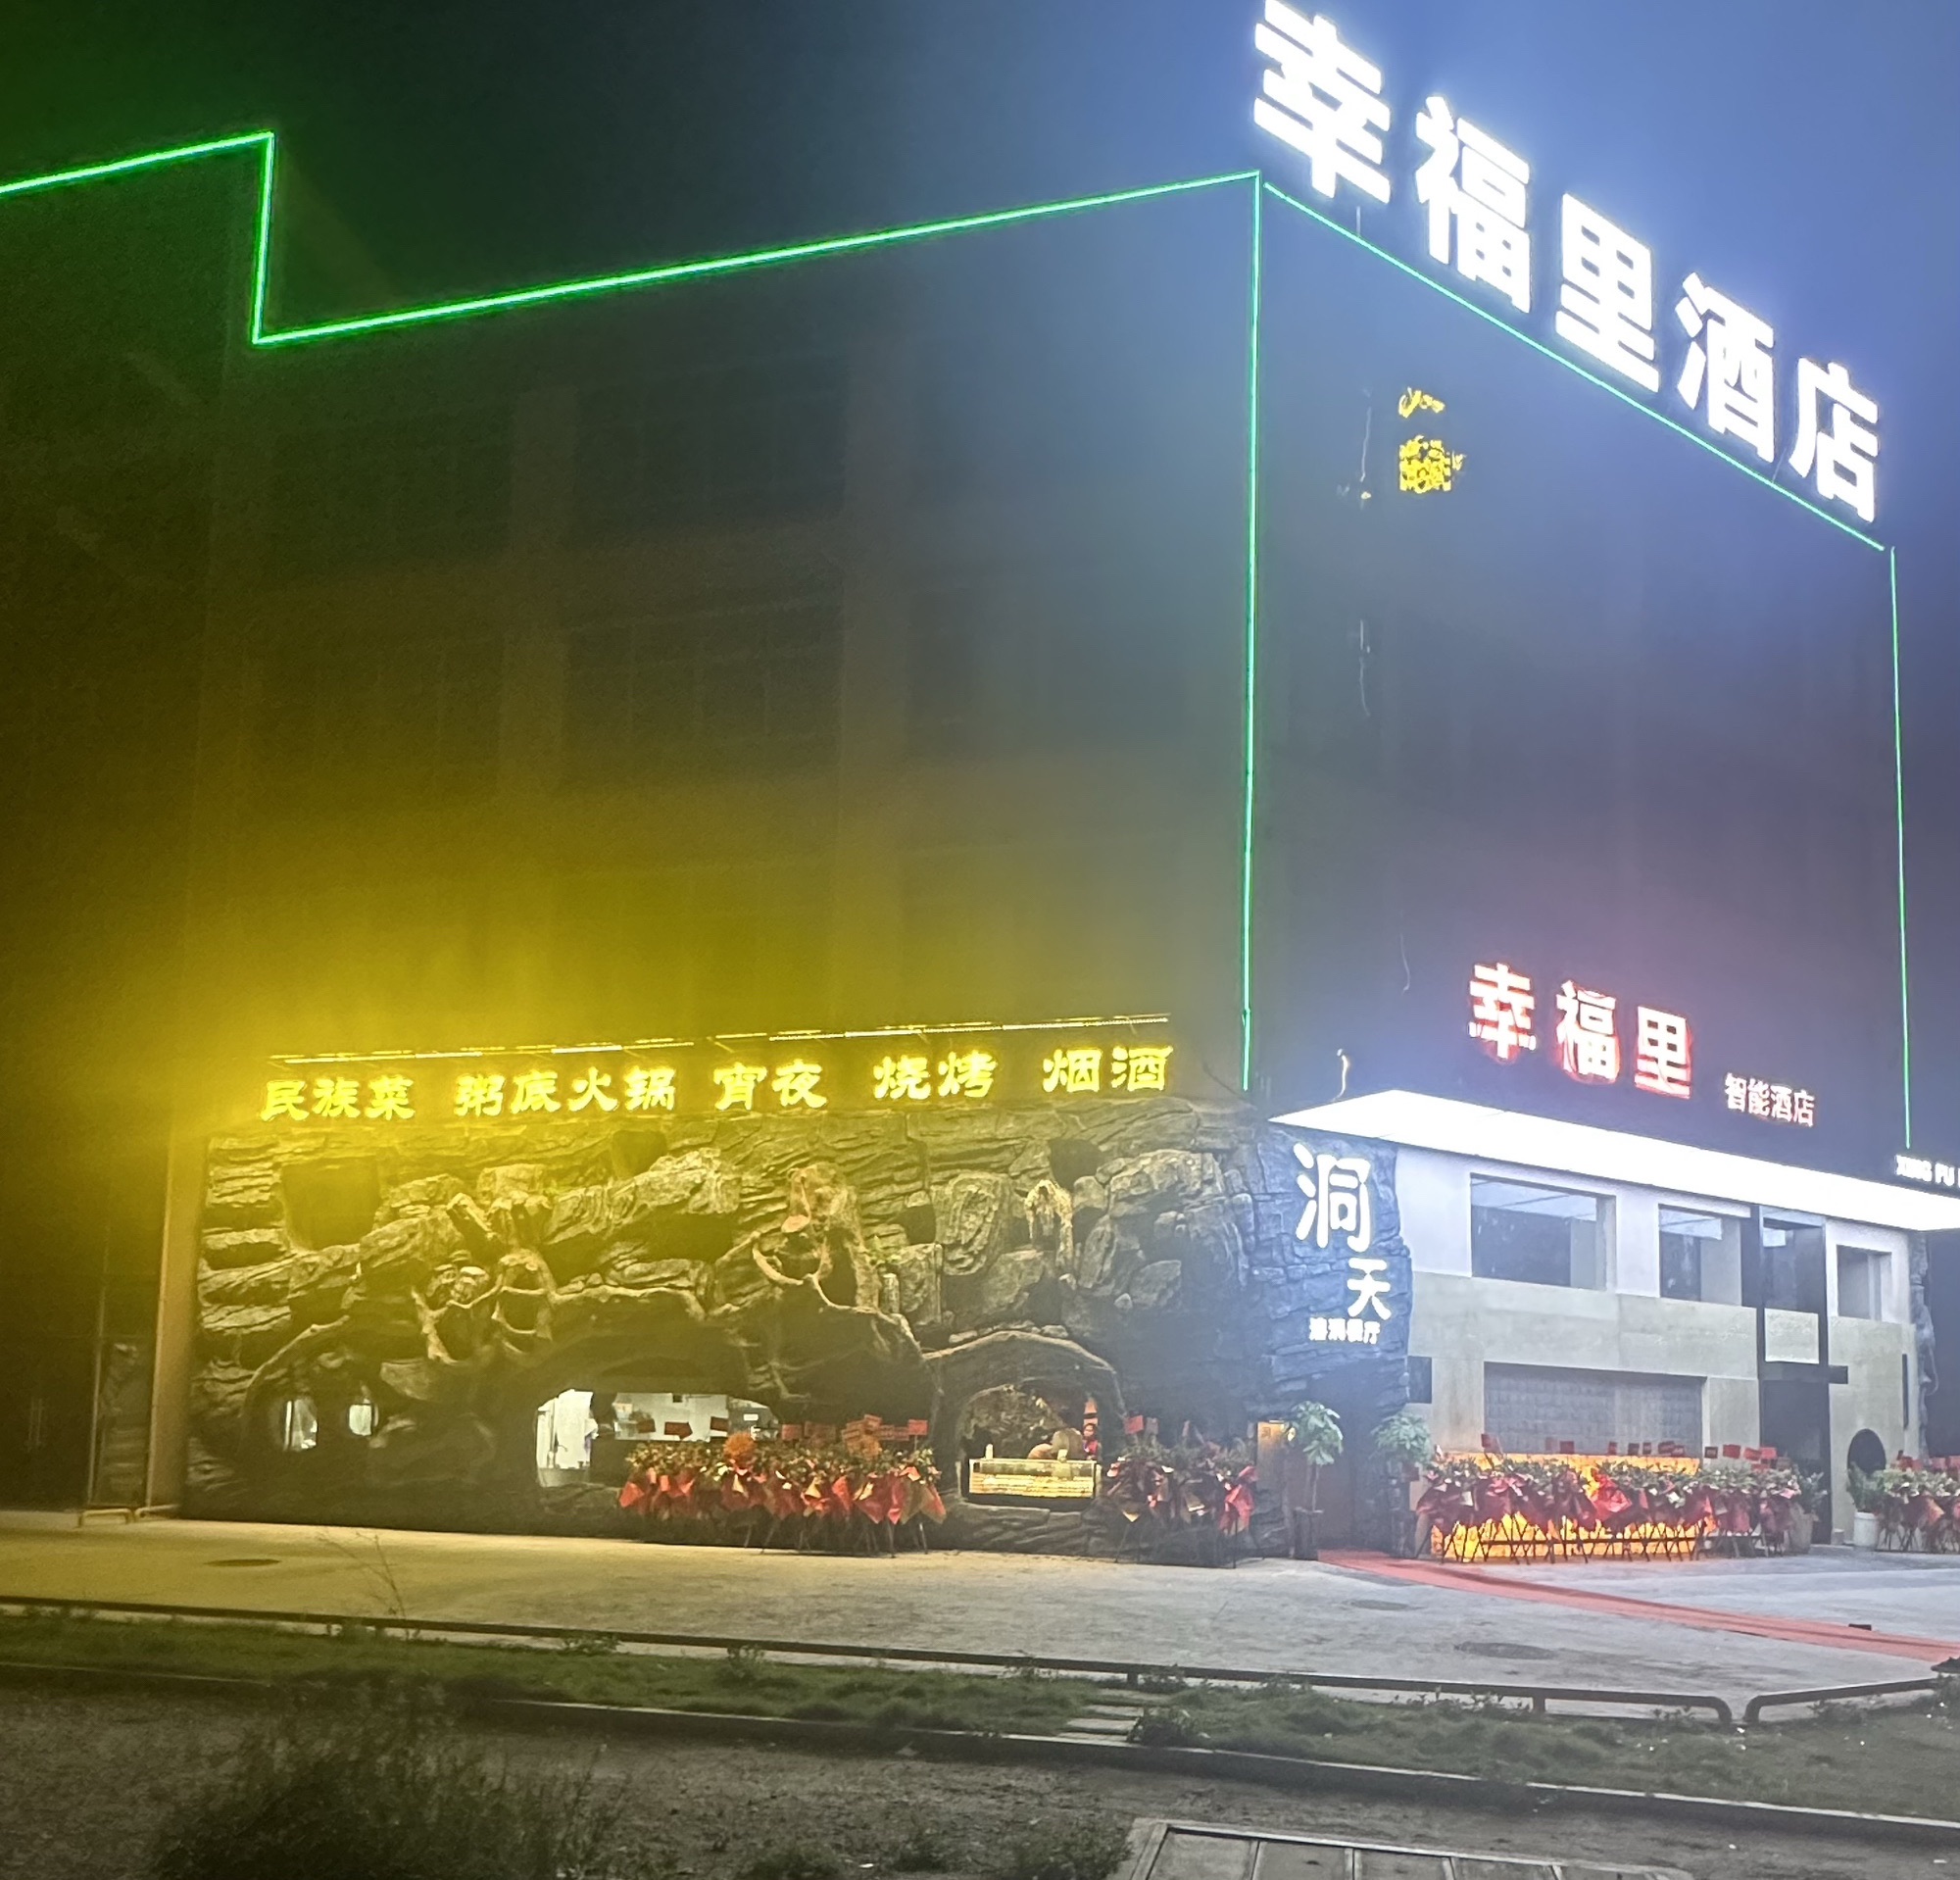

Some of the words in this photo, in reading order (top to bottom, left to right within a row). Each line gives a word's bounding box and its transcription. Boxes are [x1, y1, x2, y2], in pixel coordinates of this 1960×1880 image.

[1254, 0, 1879, 522] 幸福里酒店
[260, 1074, 416, 1122] 民族菜
[453, 1064, 677, 1117] 粥底火锅
[712, 1061, 828, 1110] 宵夜
[873, 1050, 998, 1100] 烧烤
[1043, 1046, 1174, 1093] 烟酒
[1468, 963, 1692, 1100] 幸福里
[1725, 1072, 1816, 1128] 智能酒店
[1294, 1143, 1392, 1320] 洞天
